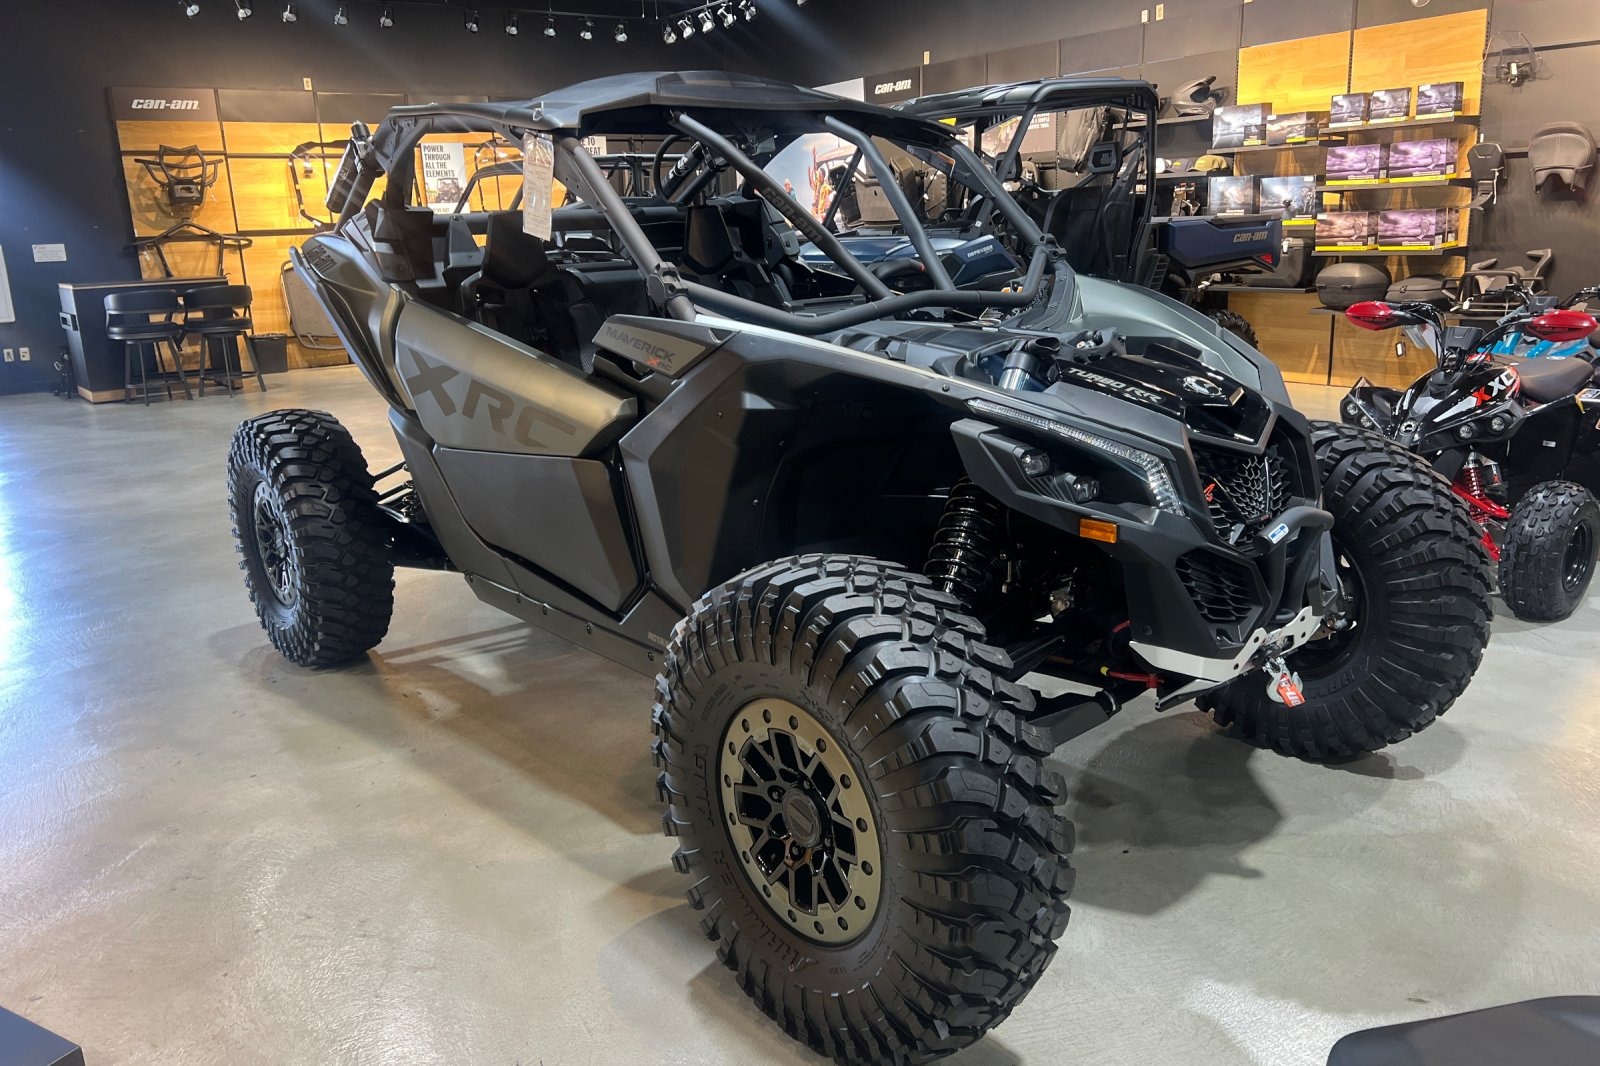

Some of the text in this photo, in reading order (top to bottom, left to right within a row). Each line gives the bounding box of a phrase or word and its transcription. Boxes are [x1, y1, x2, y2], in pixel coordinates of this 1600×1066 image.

[874, 78, 912, 95] can-am
[131, 98, 200, 110] can-am
[423, 144, 444, 152] POWER
[424, 153, 451, 161] THROUGH
[425, 161, 447, 169] ALL THE
[426, 169, 455, 178] ELEMENTS
[762, 187, 823, 242] can-am
[1233, 231, 1268, 243] can-am
[306, 243, 338, 274] can-am
[605, 326, 676, 364] MAVERICK
[1068, 367, 1162, 403] TURBO RR
[406, 347, 577, 449] XRC
